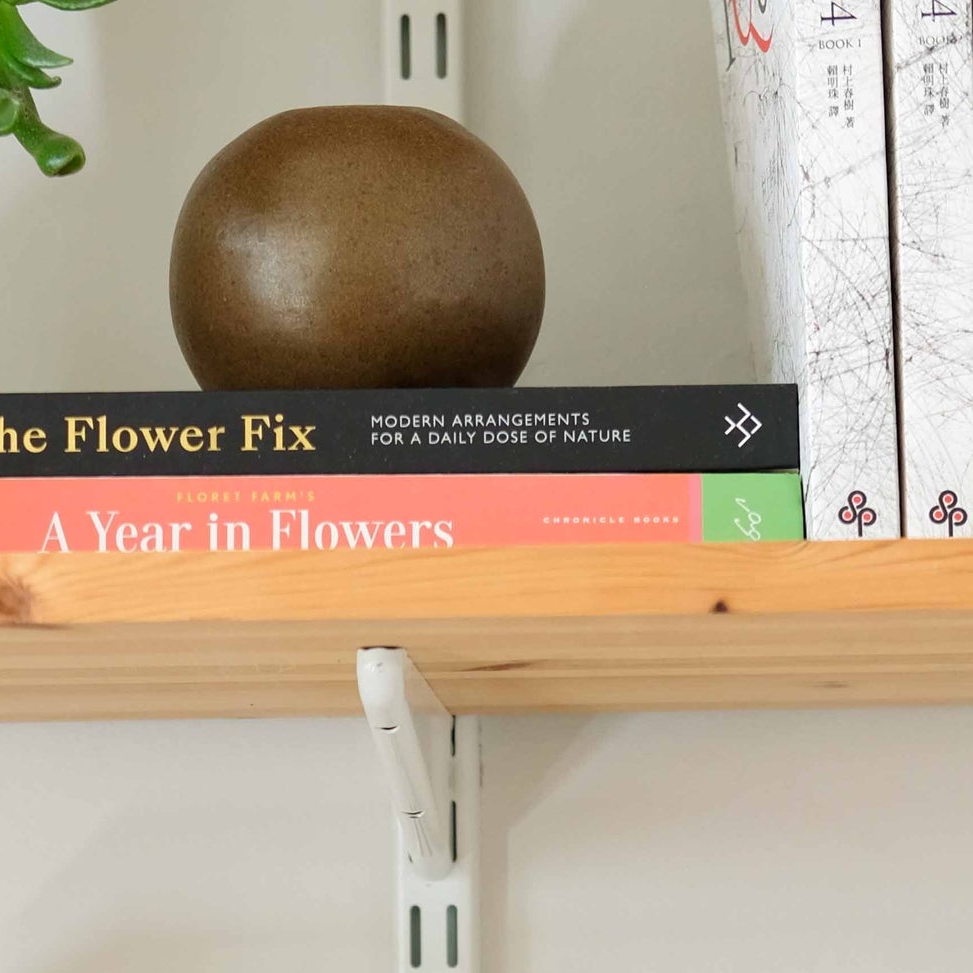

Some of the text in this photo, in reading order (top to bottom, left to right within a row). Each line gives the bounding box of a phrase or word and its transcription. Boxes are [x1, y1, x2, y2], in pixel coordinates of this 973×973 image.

[818, 39, 854, 49] BOOK
[371, 413, 590, 428] MODERN ARRANGEMENTS
[64, 416, 225, 453] Flower
[241, 413, 317, 452] Fix
[371, 429, 631, 445] FOR A DAILY DOSE OF NATURE
[177, 490, 315, 503] FLORET FARM'S
[543, 515, 679, 524] CHRONICLE BOOKS
[37, 508, 454, 553] A Year in Flowers
